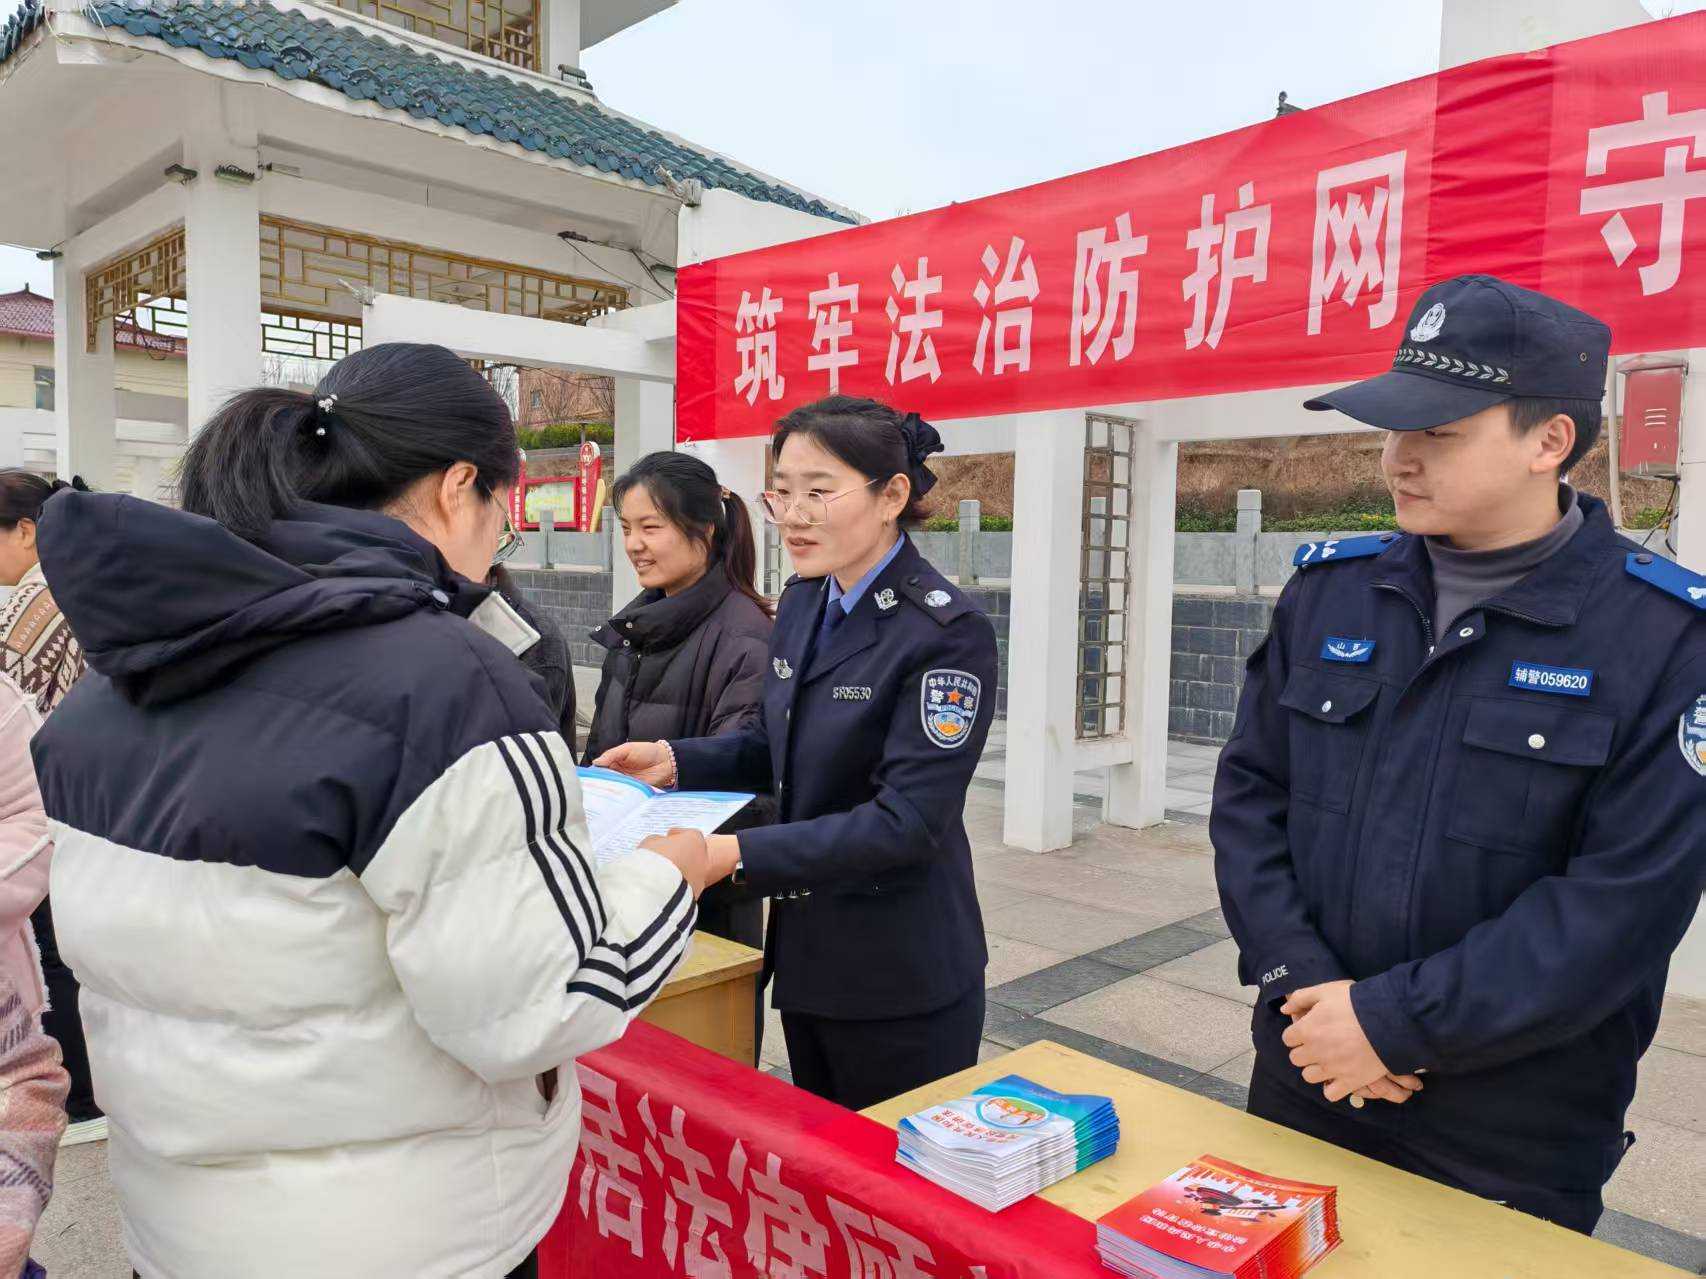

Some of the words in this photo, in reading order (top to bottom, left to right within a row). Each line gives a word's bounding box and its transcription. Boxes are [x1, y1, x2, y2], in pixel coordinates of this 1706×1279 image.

[734, 149, 1408, 405] 筑牢法治防护网
[1580, 92, 1706, 298] 守
[1514, 667, 1588, 690] 辅警059620
[578, 1060, 988, 1279] 居法律
